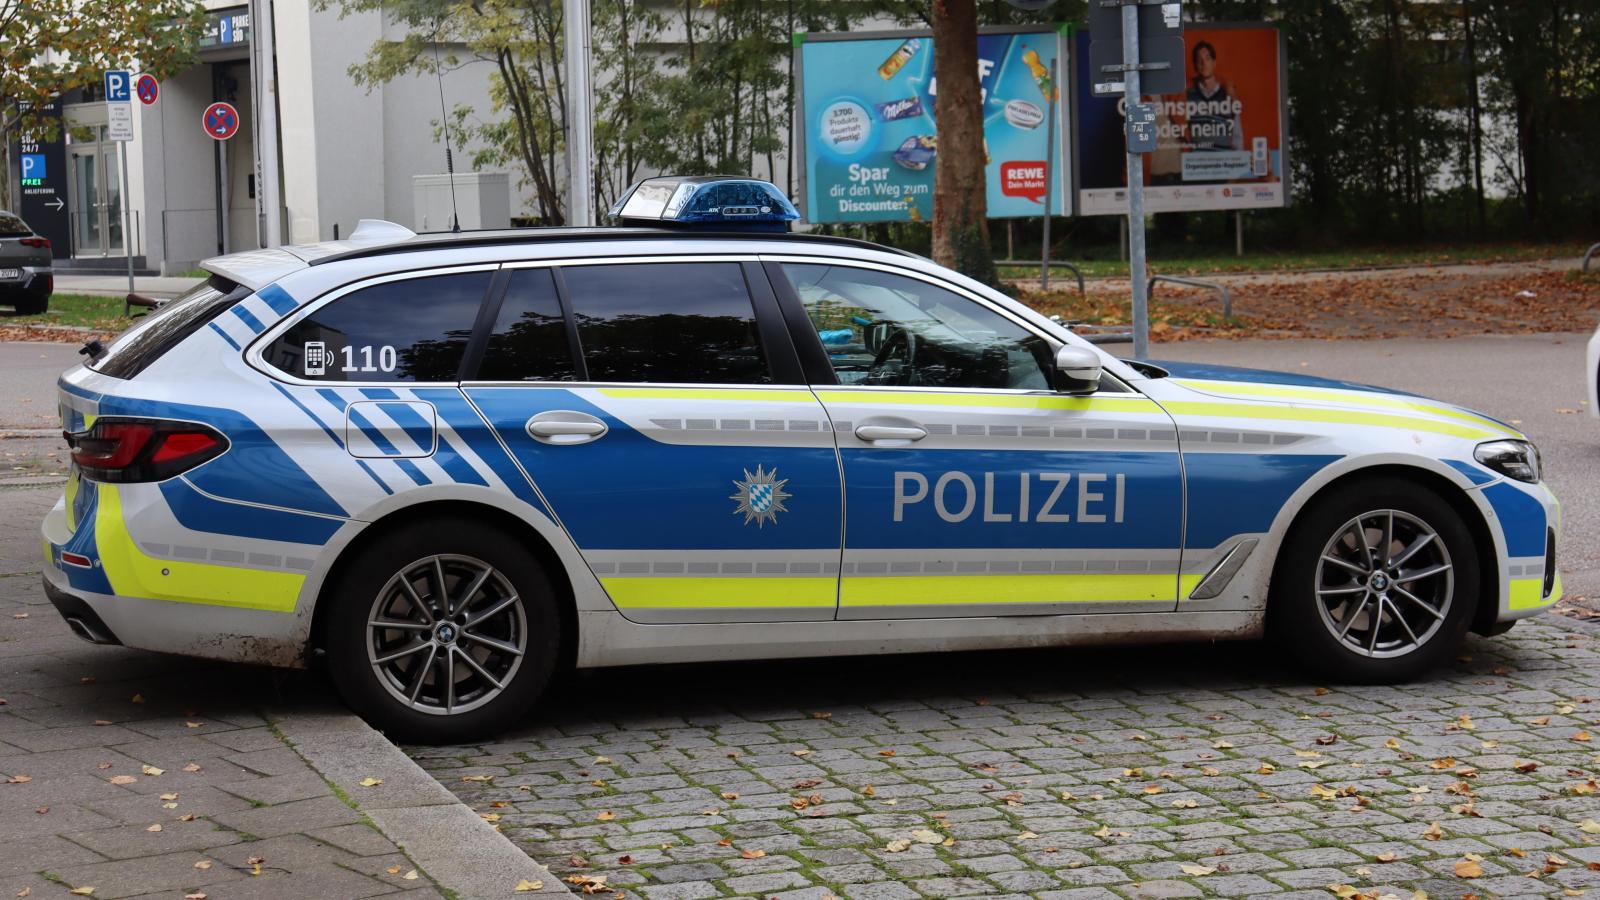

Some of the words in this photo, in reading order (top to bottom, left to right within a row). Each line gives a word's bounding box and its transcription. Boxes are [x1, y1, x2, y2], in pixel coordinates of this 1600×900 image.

[109, 74, 123, 98] P
[1191, 118, 1235, 137] nein?
[21, 144, 39, 153] 24/7
[22, 157, 34, 178] P
[848, 163, 890, 185] Spar
[1008, 168, 1044, 179] REWE
[830, 184, 846, 197] dir
[849, 184, 870, 196] den
[874, 183, 900, 199] Weg
[903, 184, 928, 195] zum
[1008, 181, 1023, 189] Dein
[341, 345, 396, 372] 110
[893, 470, 1126, 523] POLIZEI
